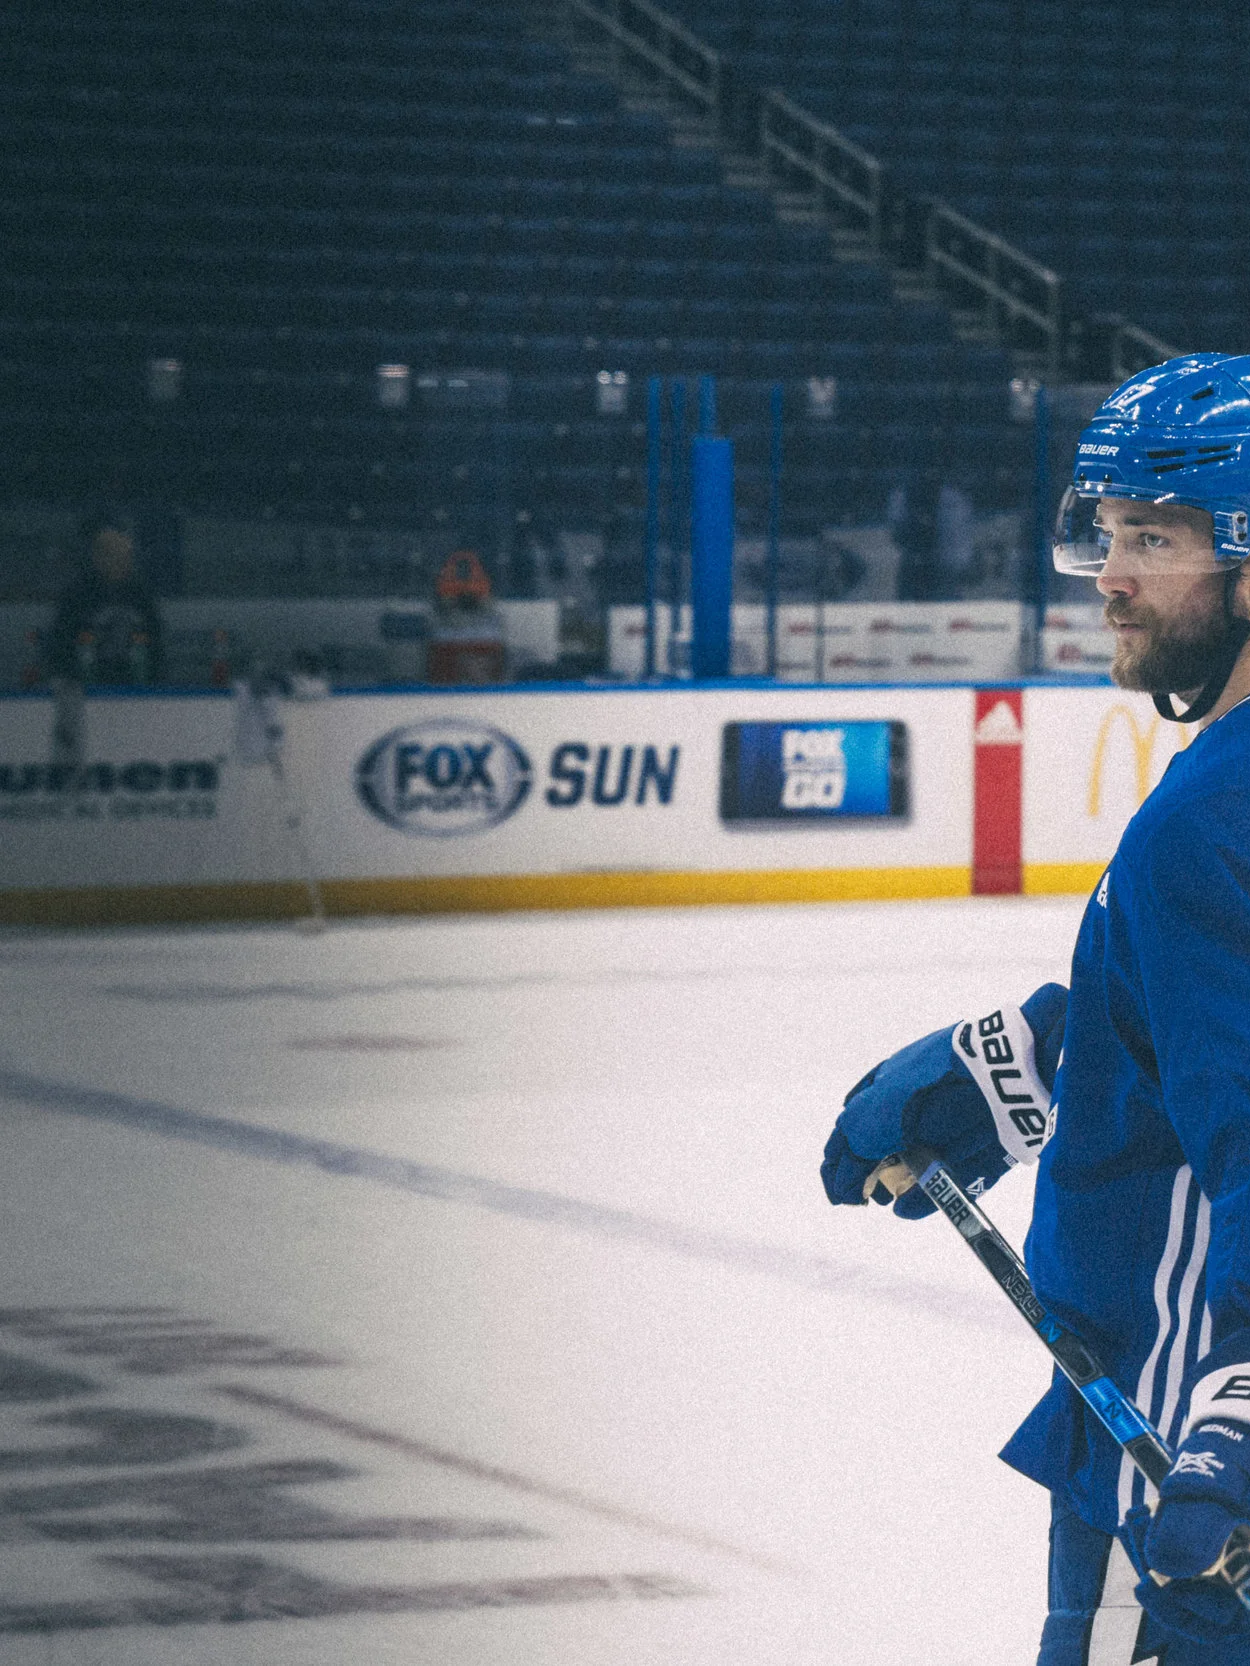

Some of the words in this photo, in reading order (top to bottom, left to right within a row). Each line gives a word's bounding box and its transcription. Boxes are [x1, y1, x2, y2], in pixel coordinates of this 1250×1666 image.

[394, 742, 495, 792] FOX
[546, 743, 680, 807] SUN
[781, 771, 846, 809] GO
